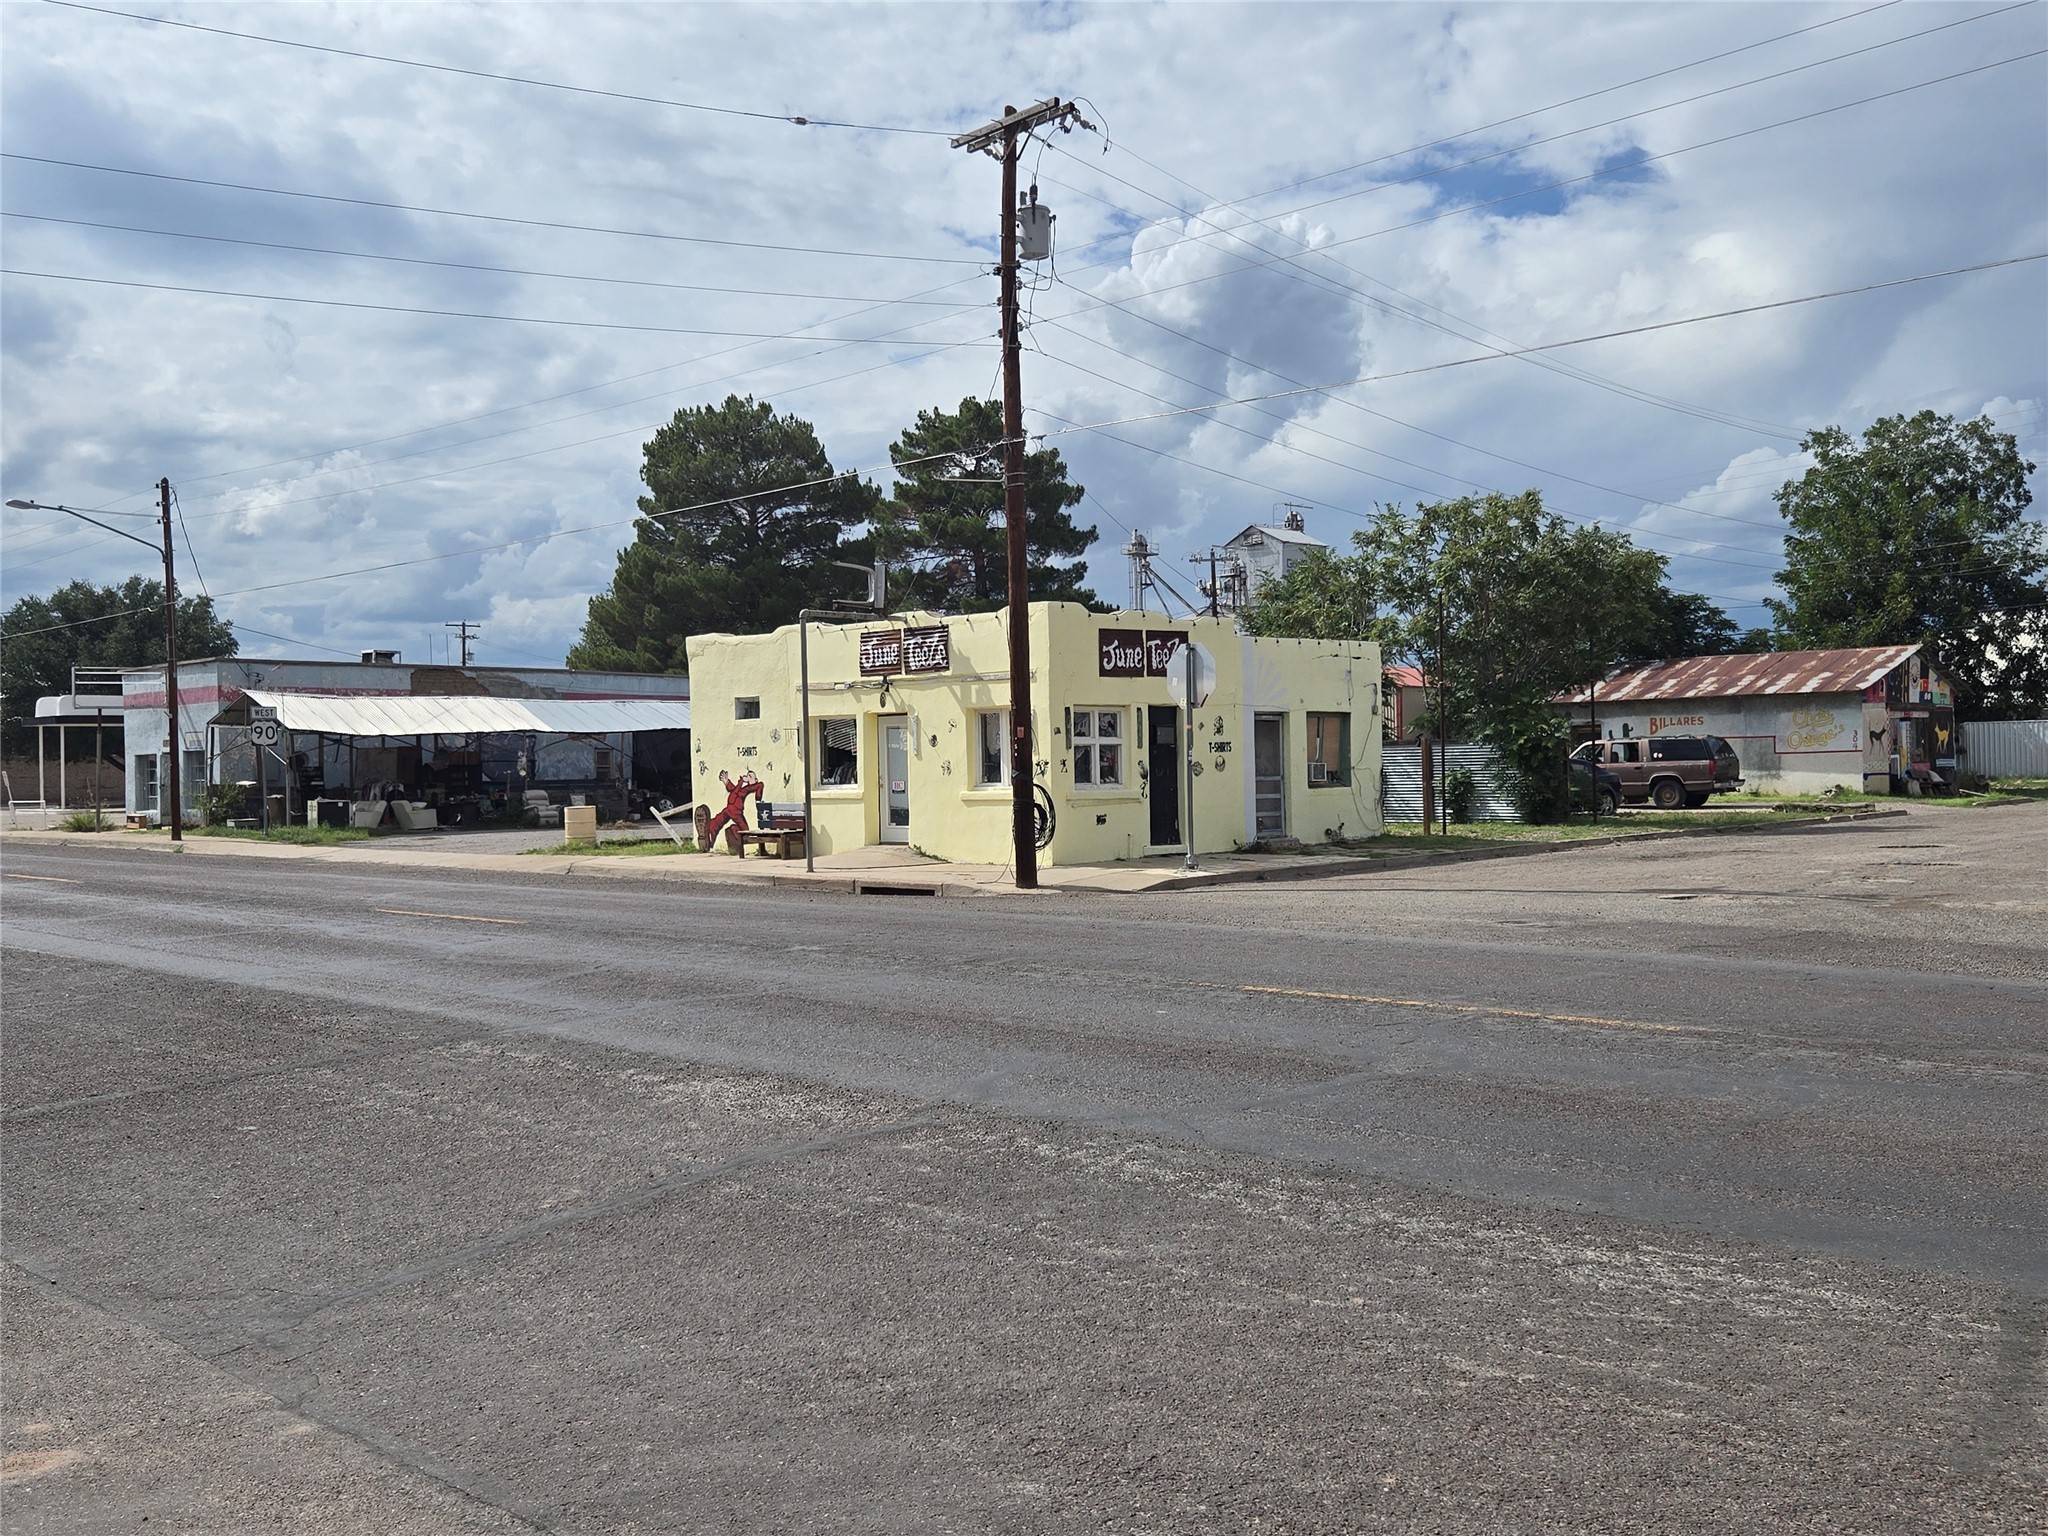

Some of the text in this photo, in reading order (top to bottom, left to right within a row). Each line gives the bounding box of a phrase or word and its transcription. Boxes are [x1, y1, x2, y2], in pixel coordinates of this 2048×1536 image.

[861, 638, 899, 669] June
[1103, 640, 1143, 670] June
[253, 708, 274, 717] WEST
[253, 725, 276, 740] 90
[1649, 716, 1704, 735] BILLARES
[736, 746, 758, 757] T-SHIRTS
[1208, 741, 1232, 753] T-SHIRTS
